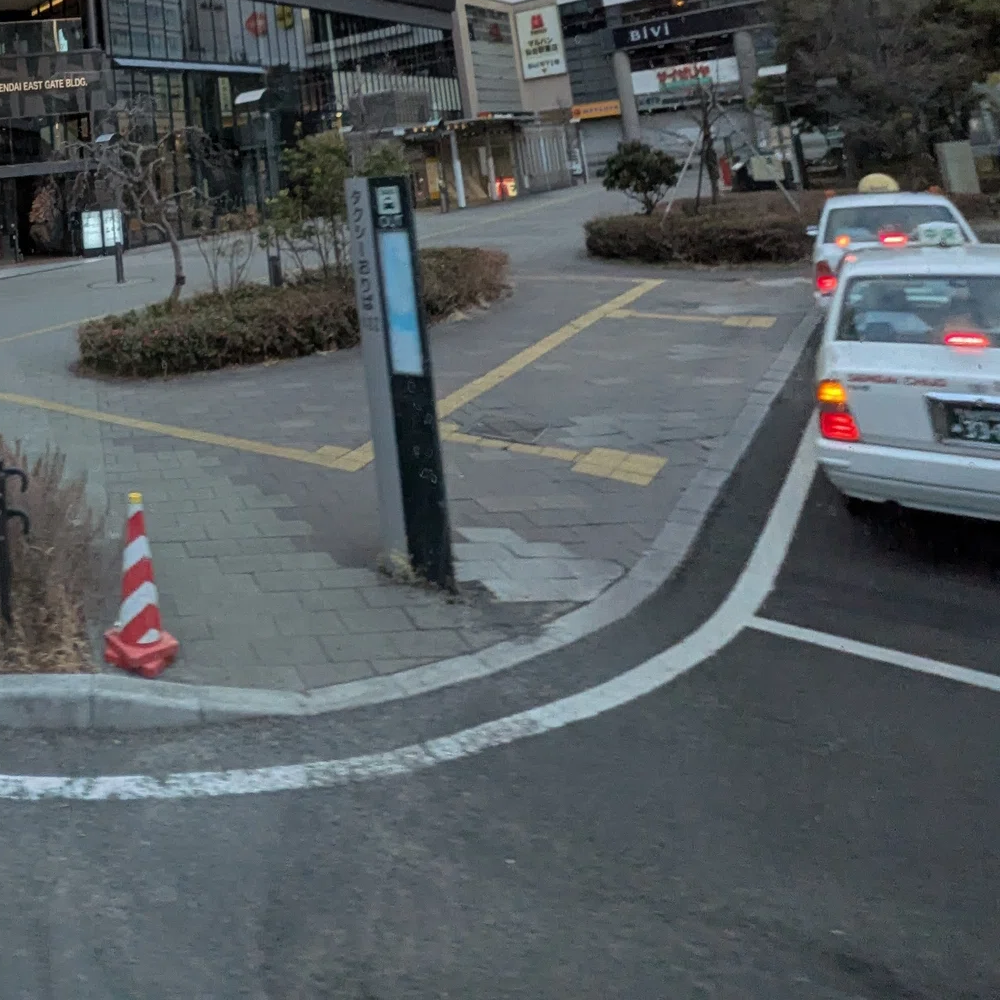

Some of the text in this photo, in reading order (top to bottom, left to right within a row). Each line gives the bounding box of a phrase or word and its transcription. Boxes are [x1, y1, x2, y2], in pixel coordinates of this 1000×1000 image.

[23, 81, 43, 91] EAST
[44, 79, 64, 89] GATE
[65, 77, 88, 88] BLDG.
